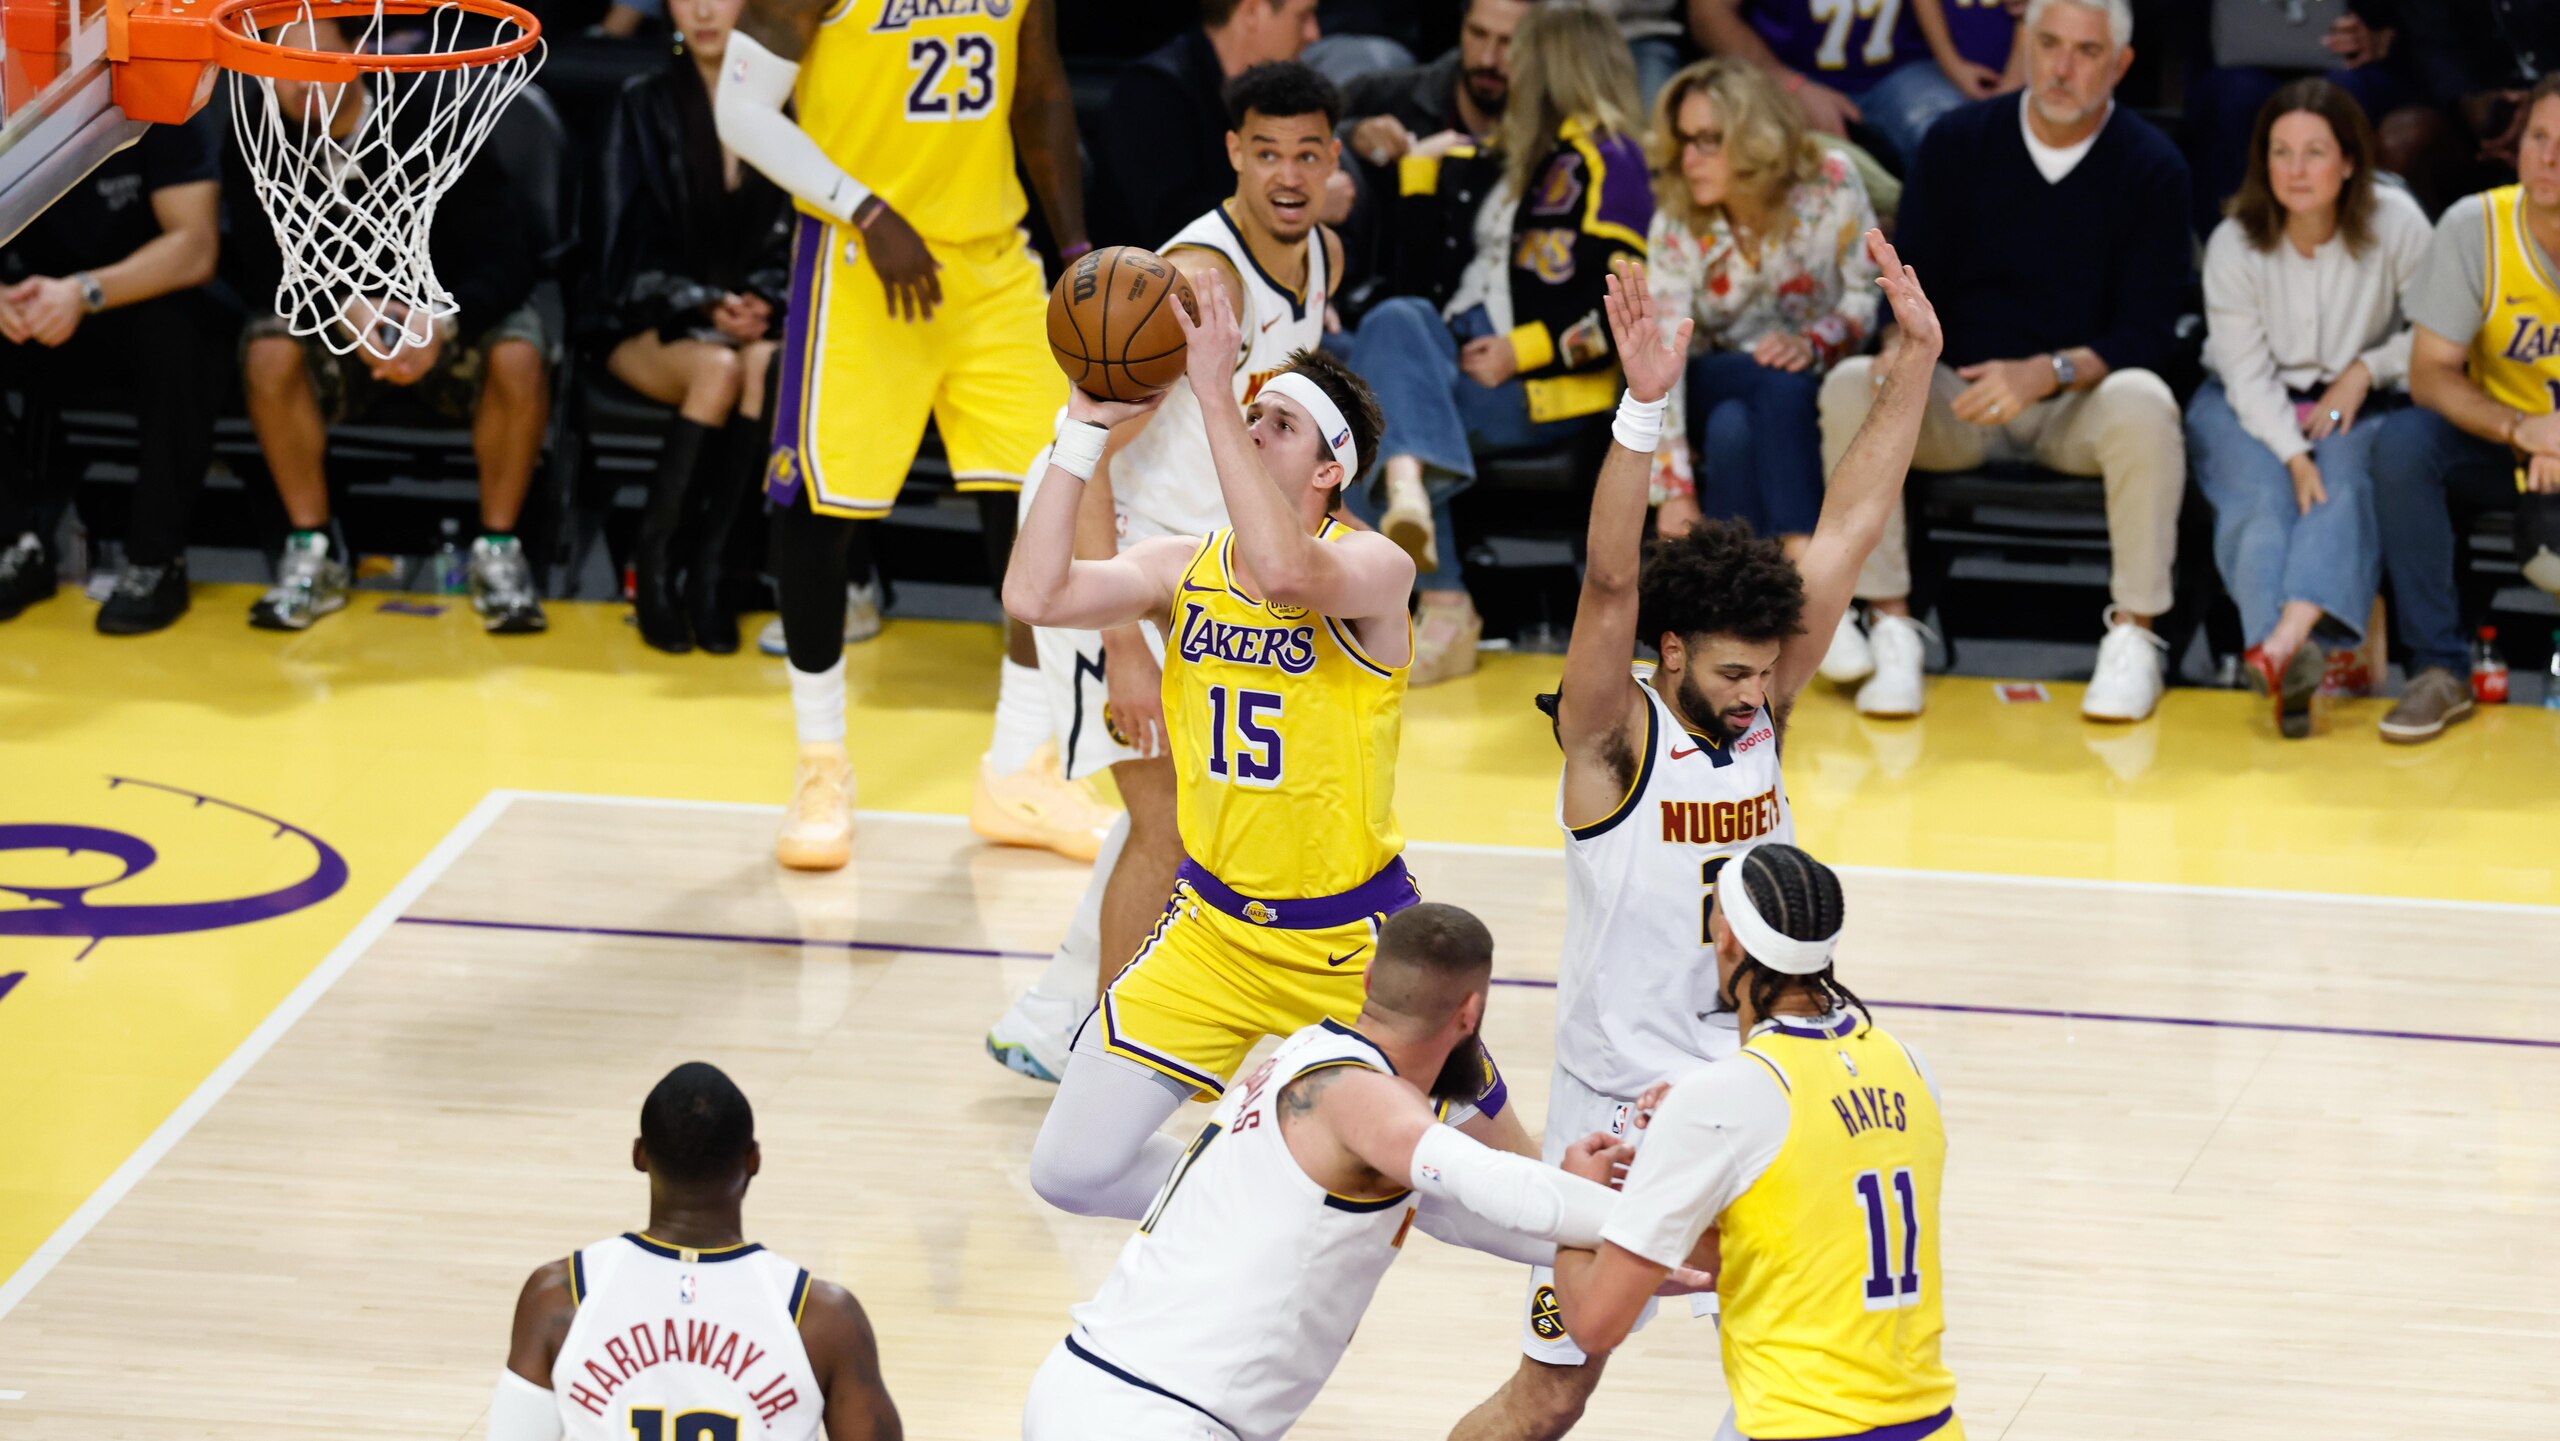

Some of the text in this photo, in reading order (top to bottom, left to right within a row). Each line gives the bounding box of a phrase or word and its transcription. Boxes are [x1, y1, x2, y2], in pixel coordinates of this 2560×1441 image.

[904, 31, 998, 123] 23
[1180, 602, 1317, 675] LAKERS
[1207, 684, 1284, 788] 15
[1831, 1087, 1906, 1137] HAYES
[1852, 1167, 1922, 1312] 11
[568, 1318, 766, 1417] HARDAWAY
[748, 1372, 799, 1430] JR.
